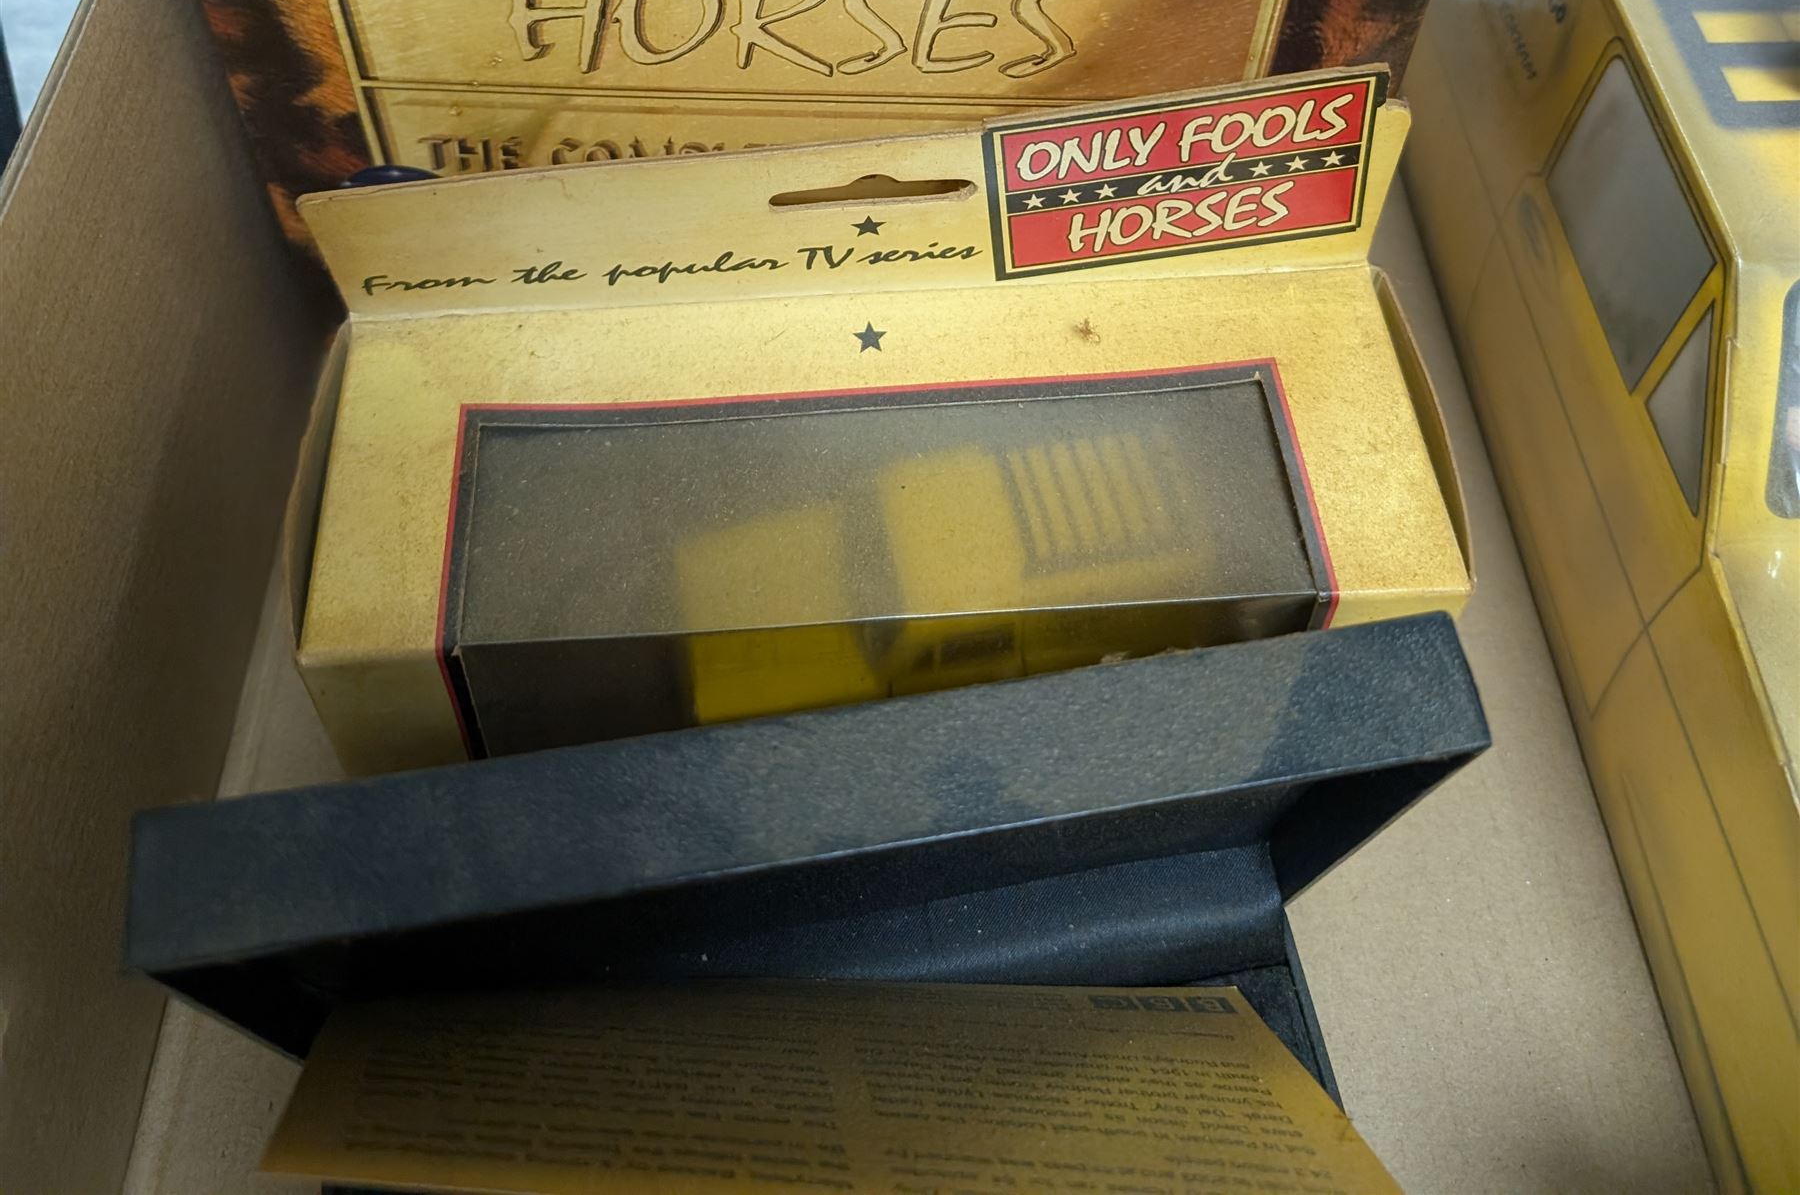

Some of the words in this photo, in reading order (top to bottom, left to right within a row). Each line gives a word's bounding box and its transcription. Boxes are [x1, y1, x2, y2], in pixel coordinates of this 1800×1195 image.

[417, 135, 523, 173] THE
[1016, 120, 1173, 179] ONLY
[1176, 92, 1356, 164] FOOLS
[1136, 153, 1236, 197] and
[1064, 181, 1291, 255] HORSES
[362, 274, 497, 297] From
[511, 260, 588, 286] the
[601, 250, 792, 287] popular
[796, 245, 855, 272] TV
[849, 241, 984, 265] series
